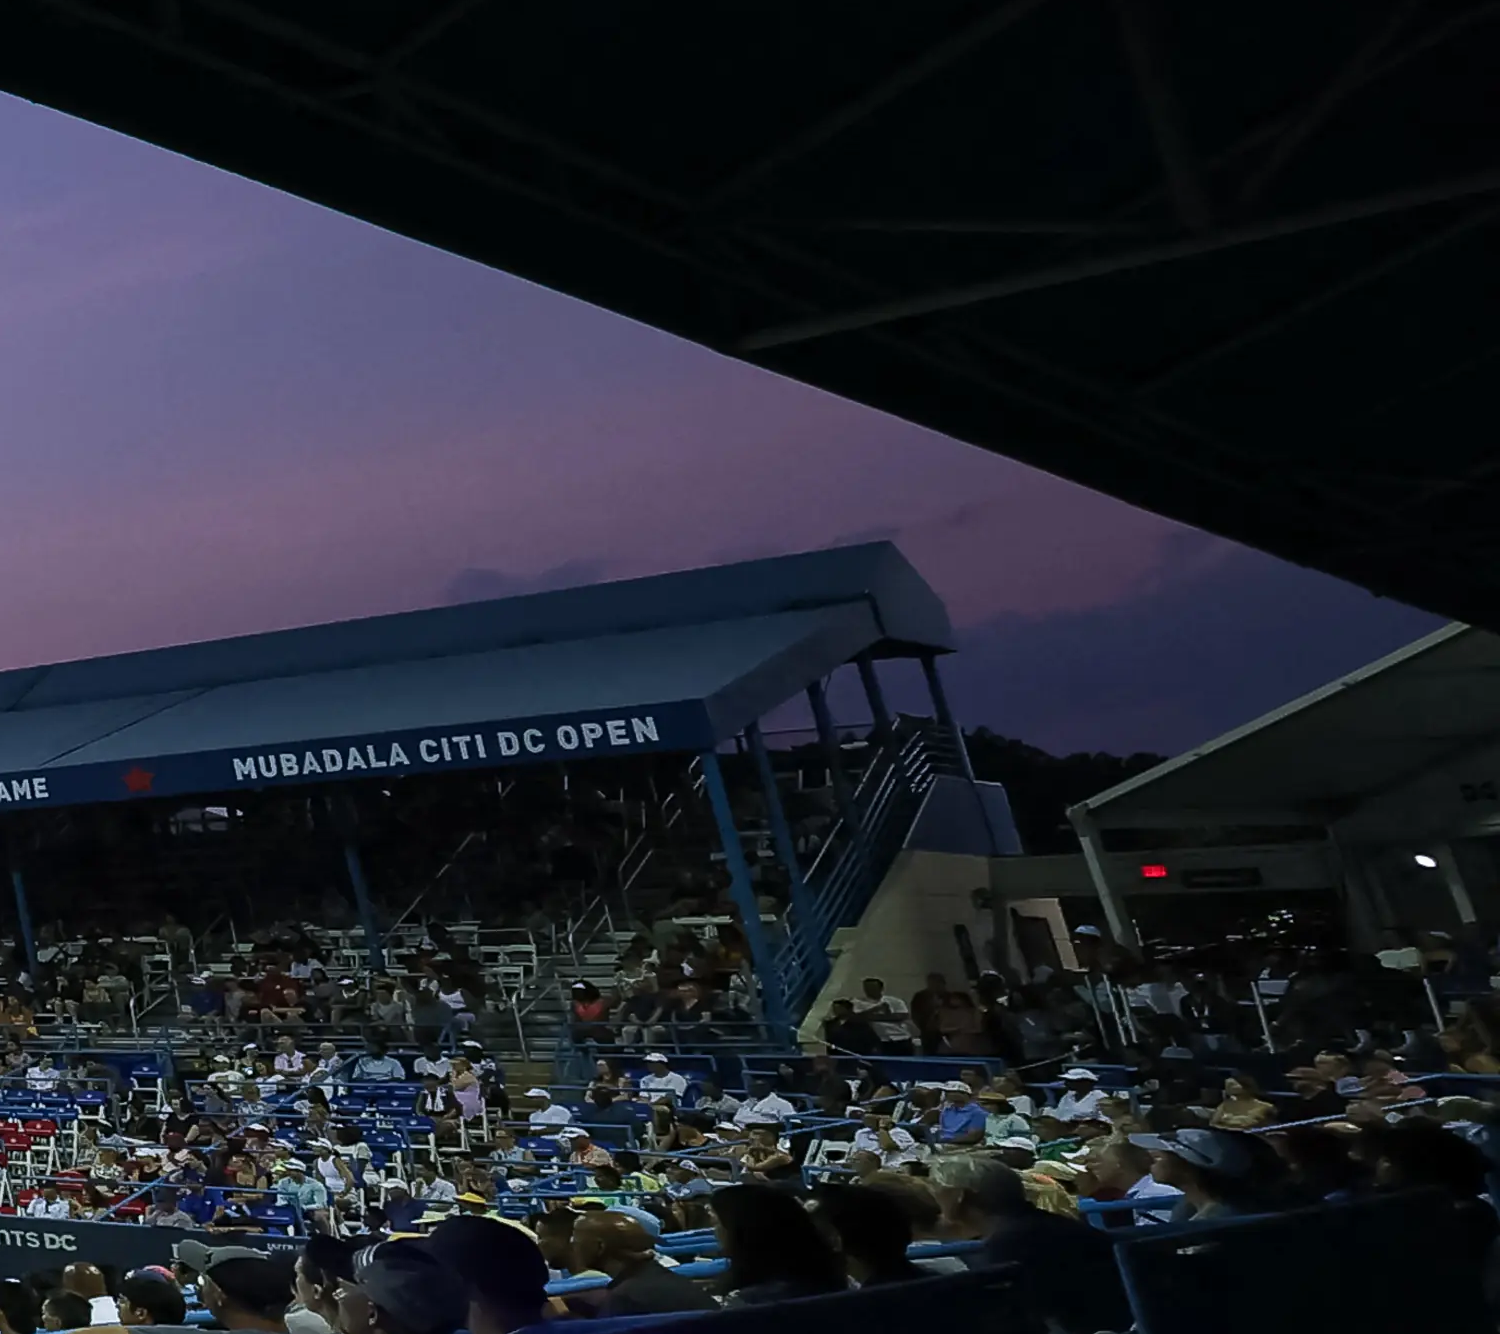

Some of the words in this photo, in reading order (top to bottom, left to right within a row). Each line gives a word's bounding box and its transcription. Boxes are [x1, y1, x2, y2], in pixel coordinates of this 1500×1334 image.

[233, 743, 410, 781] MUBADALA
[419, 734, 487, 763] CITI
[497, 728, 546, 756] DC
[557, 716, 660, 749] OPEN
